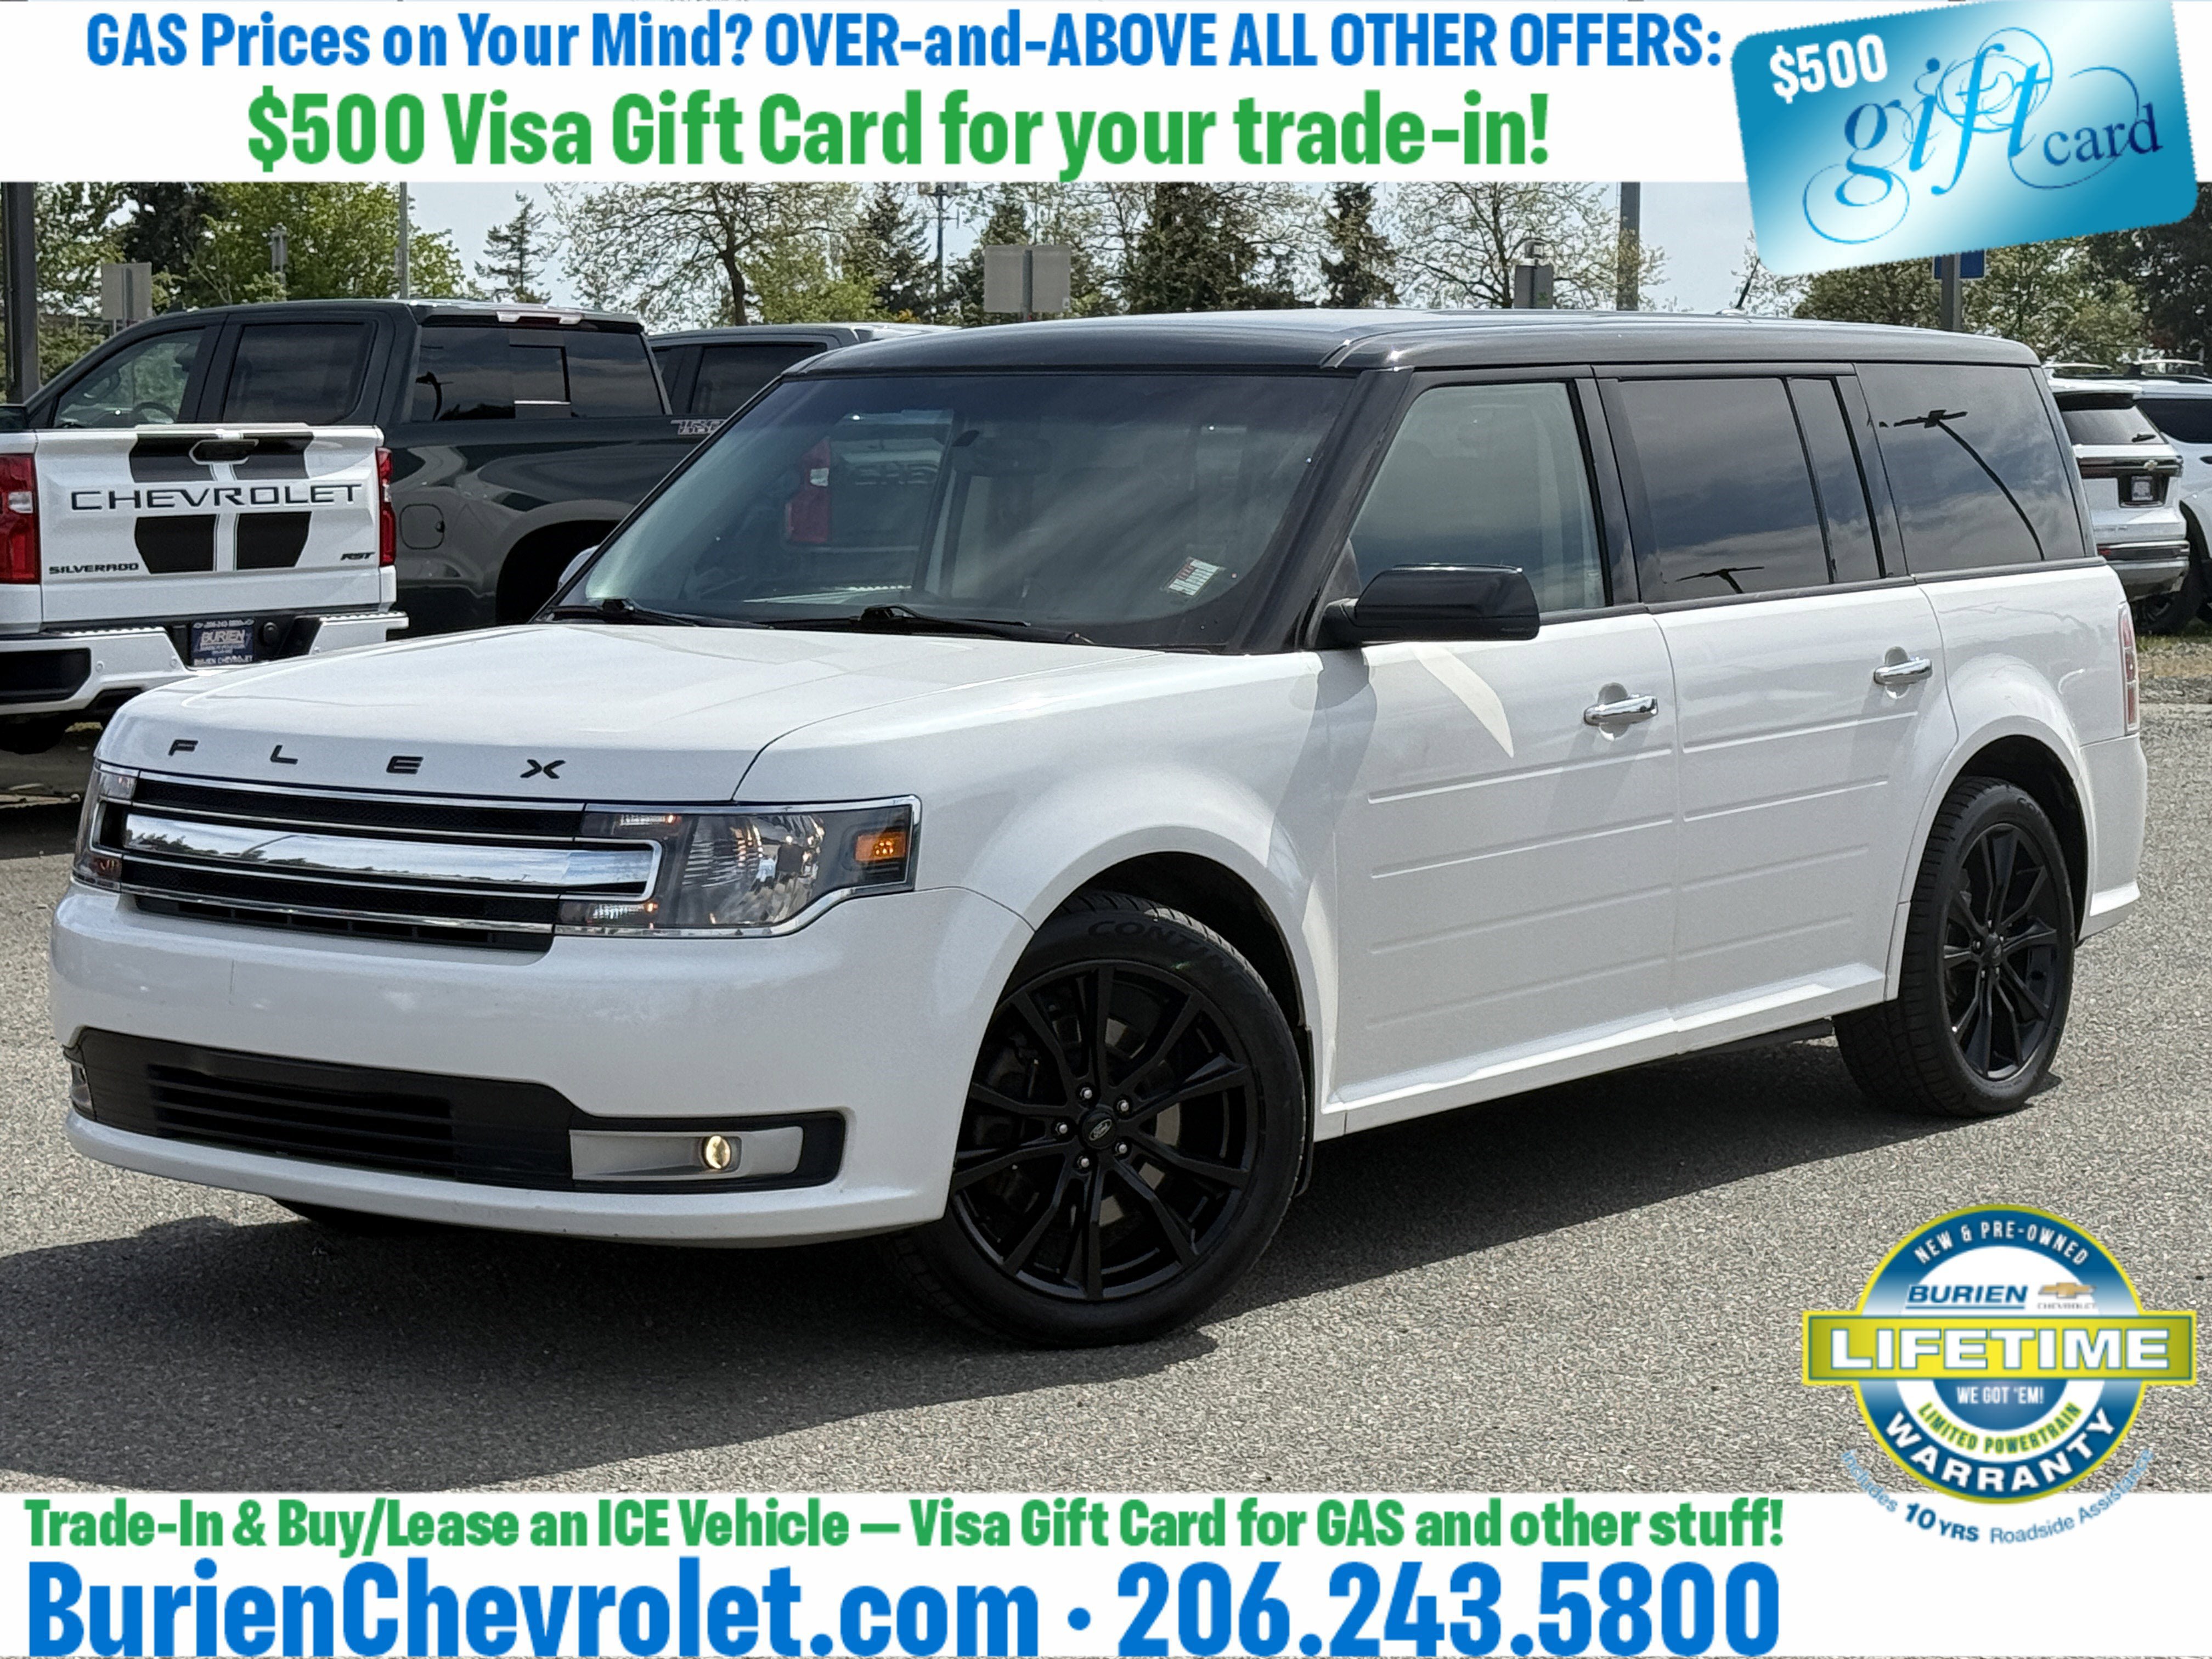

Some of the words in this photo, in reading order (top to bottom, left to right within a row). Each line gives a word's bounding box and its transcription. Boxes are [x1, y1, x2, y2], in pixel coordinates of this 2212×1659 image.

[71, 483, 362, 511] CHEVROLET
[340, 551, 376, 561] RST
[48, 562, 139, 575] SILVERADO
[201, 629, 245, 644] BURIEN
[167, 738, 566, 780] FLEX
